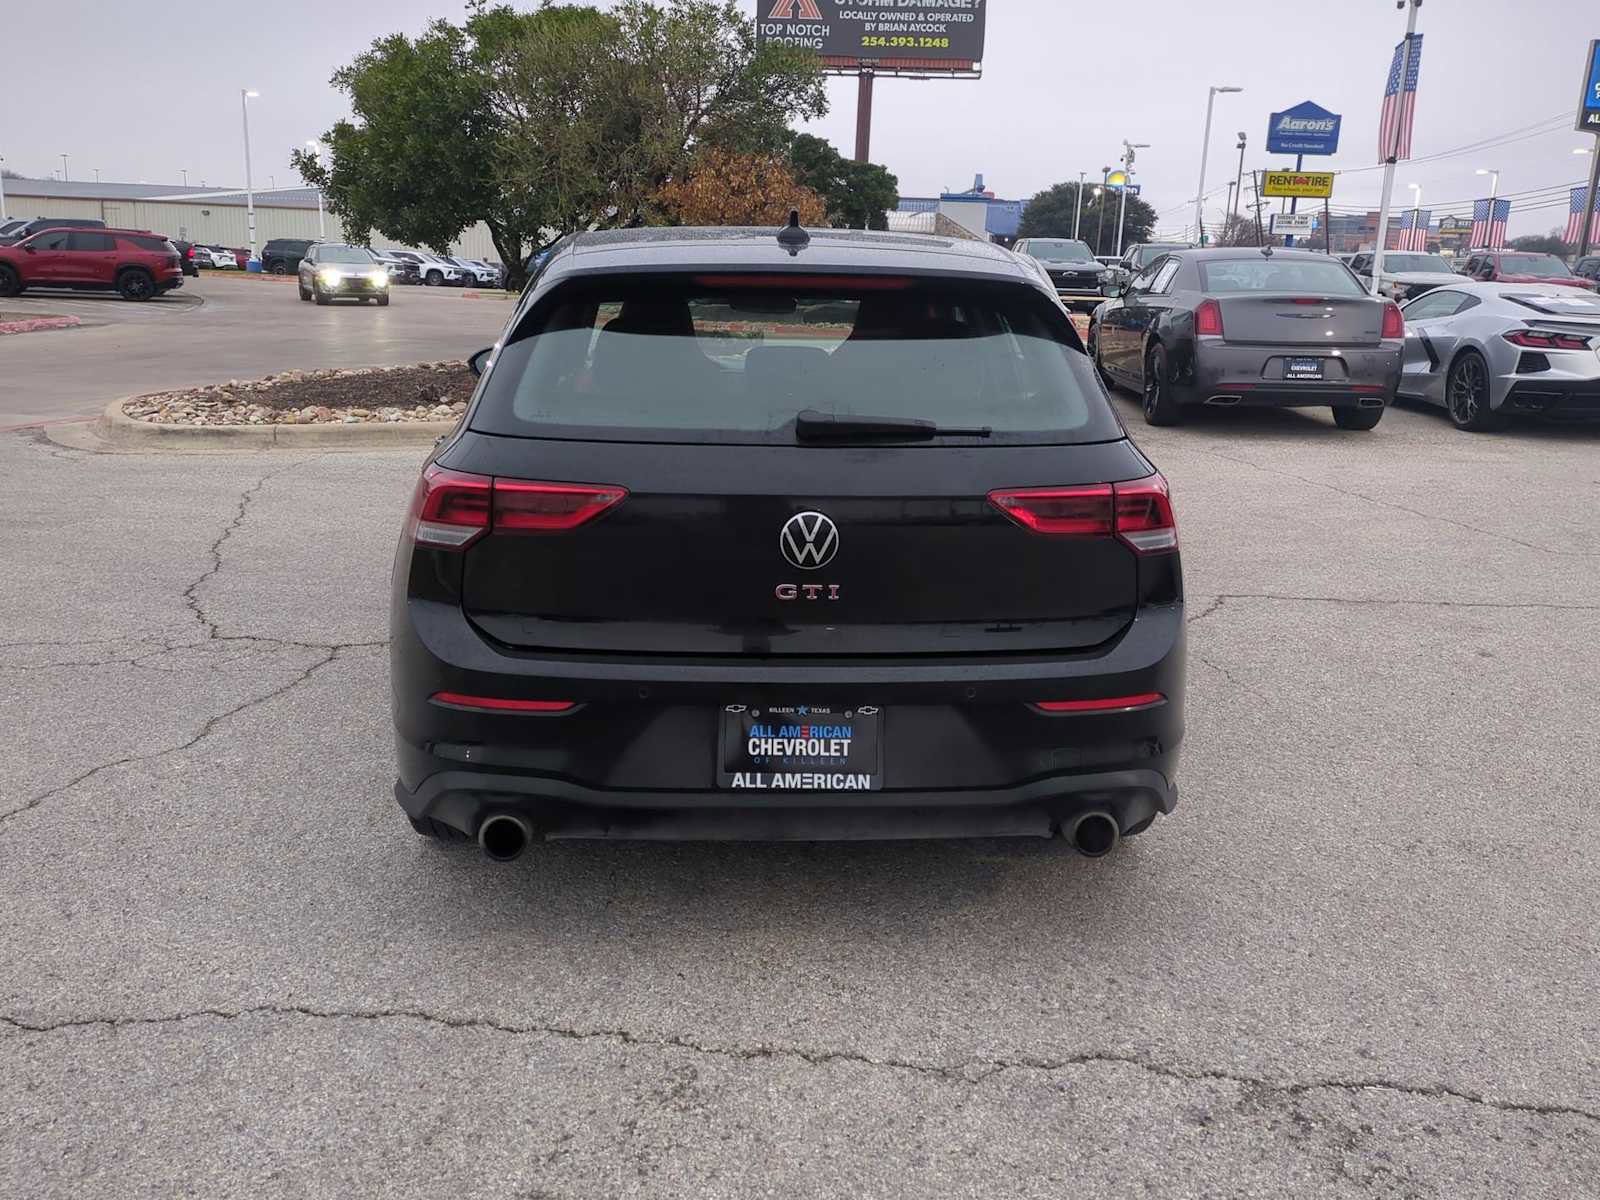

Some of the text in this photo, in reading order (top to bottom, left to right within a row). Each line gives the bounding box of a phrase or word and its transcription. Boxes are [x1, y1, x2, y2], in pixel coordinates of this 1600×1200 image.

[839, 11, 974, 22] LOCALLY OWNED & OPERATED
[760, 24, 830, 37] TOP NOTCH
[864, 23, 947, 32] BY BRIAN AYCOCK
[861, 36, 949, 48] 254.393.1248
[1278, 117, 1335, 131] Aaron's
[775, 583, 840, 600] GTI
[750, 725, 852, 738] ALL AMERICAN
[748, 738, 851, 756] CHEVROLET
[783, 757, 847, 765] KILLEEN
[731, 772, 871, 789] ALL AMERICAN
